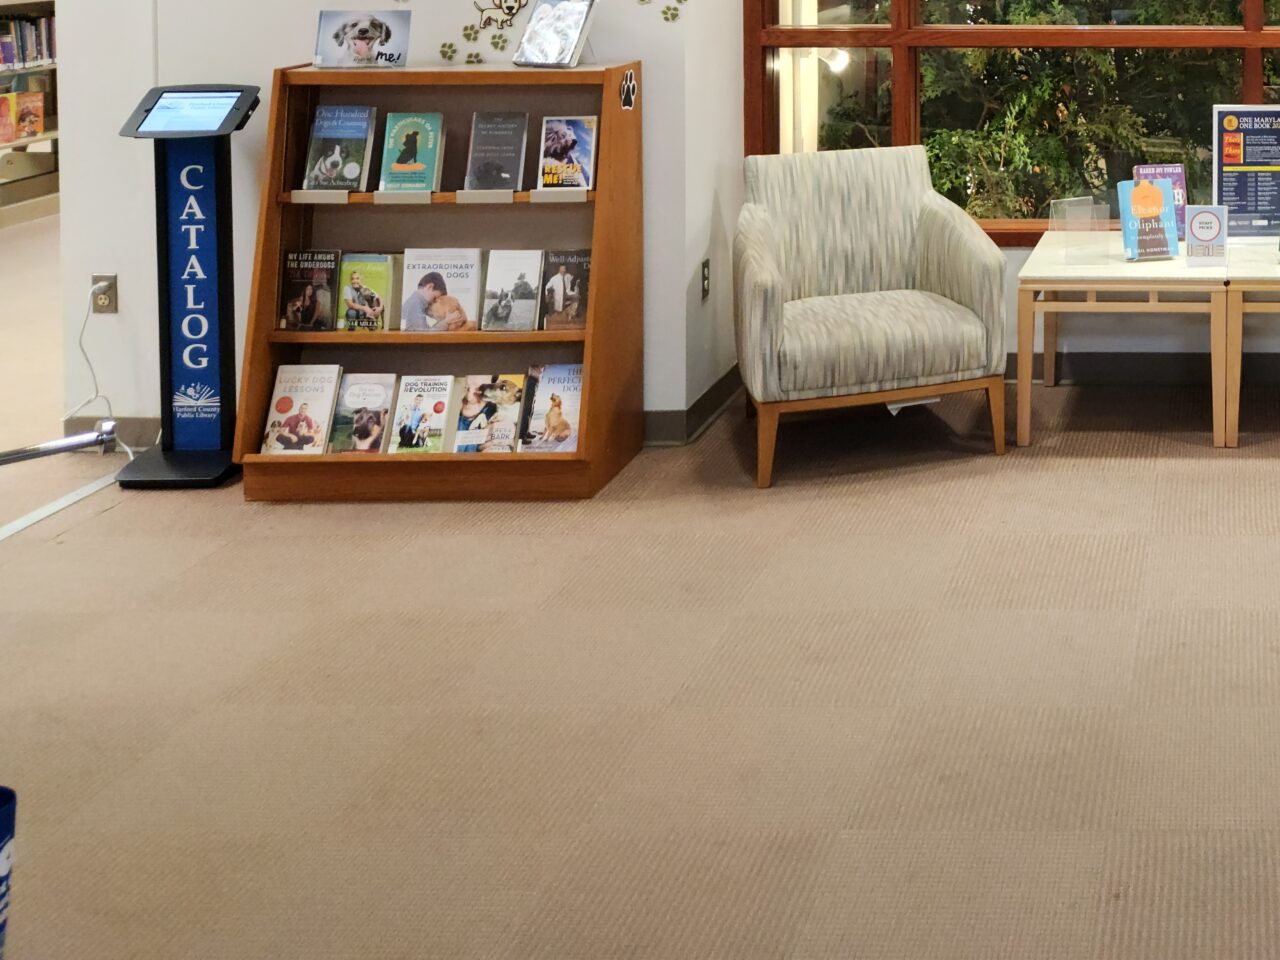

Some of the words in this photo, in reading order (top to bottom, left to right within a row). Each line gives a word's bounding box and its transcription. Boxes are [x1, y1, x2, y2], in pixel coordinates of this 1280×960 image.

[375, 50, 402, 64] me!
[316, 109, 333, 118] One
[334, 108, 369, 118] Hundred
[544, 164, 582, 174] RESCUE
[543, 173, 563, 184] ME!
[1131, 204, 1169, 215] Eleanor
[1128, 218, 1174, 232] Oliphant
[549, 255, 591, 264] Well-Adjust
[179, 164, 209, 369] CATALOG
[279, 376, 310, 384] LUCKY
[311, 376, 335, 384] DOG
[282, 385, 325, 393] LESSONS
[195, 412, 216, 420] Library
[490, 433, 511, 441] BARK
